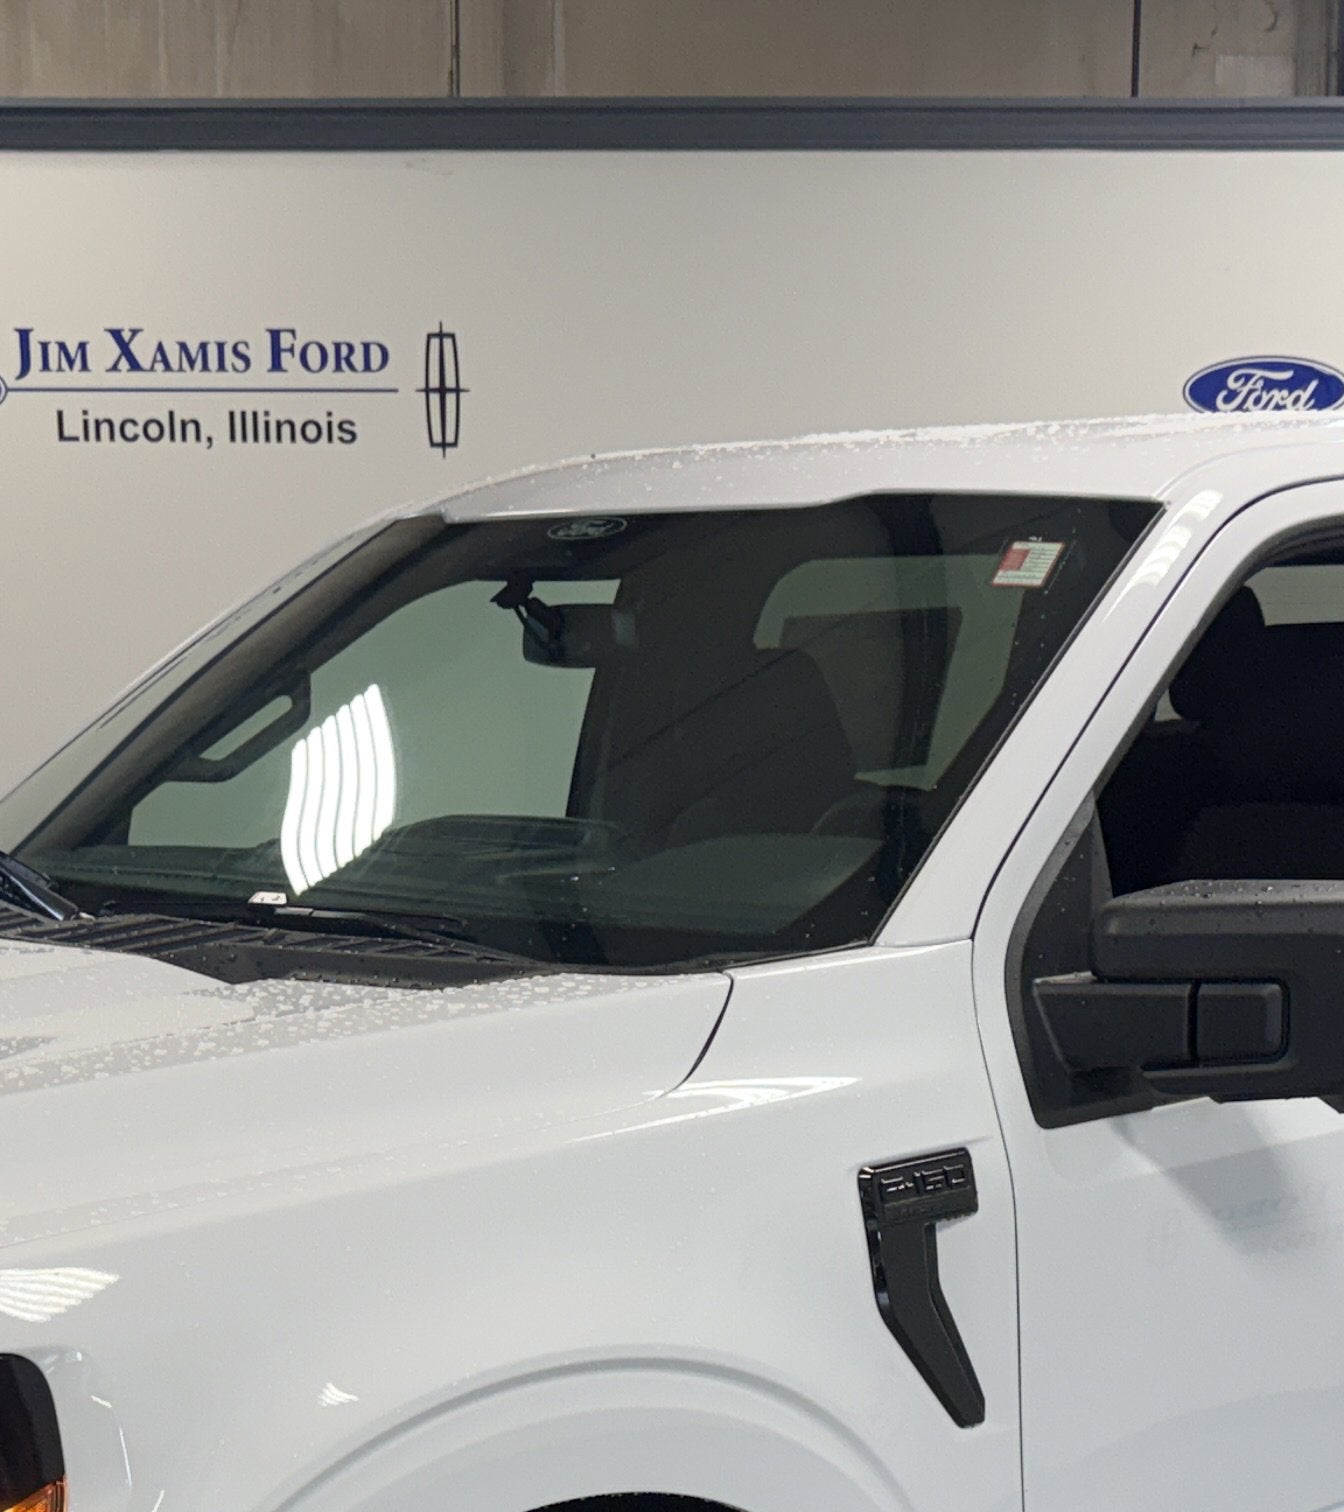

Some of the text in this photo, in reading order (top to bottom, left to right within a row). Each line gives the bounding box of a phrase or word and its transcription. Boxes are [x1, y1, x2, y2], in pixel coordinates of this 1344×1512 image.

[105, 327, 251, 373] XAMIS
[266, 327, 390, 373] FORD
[1216, 368, 1316, 413] Ford
[56, 408, 357, 447] Lincoln, Illinois
